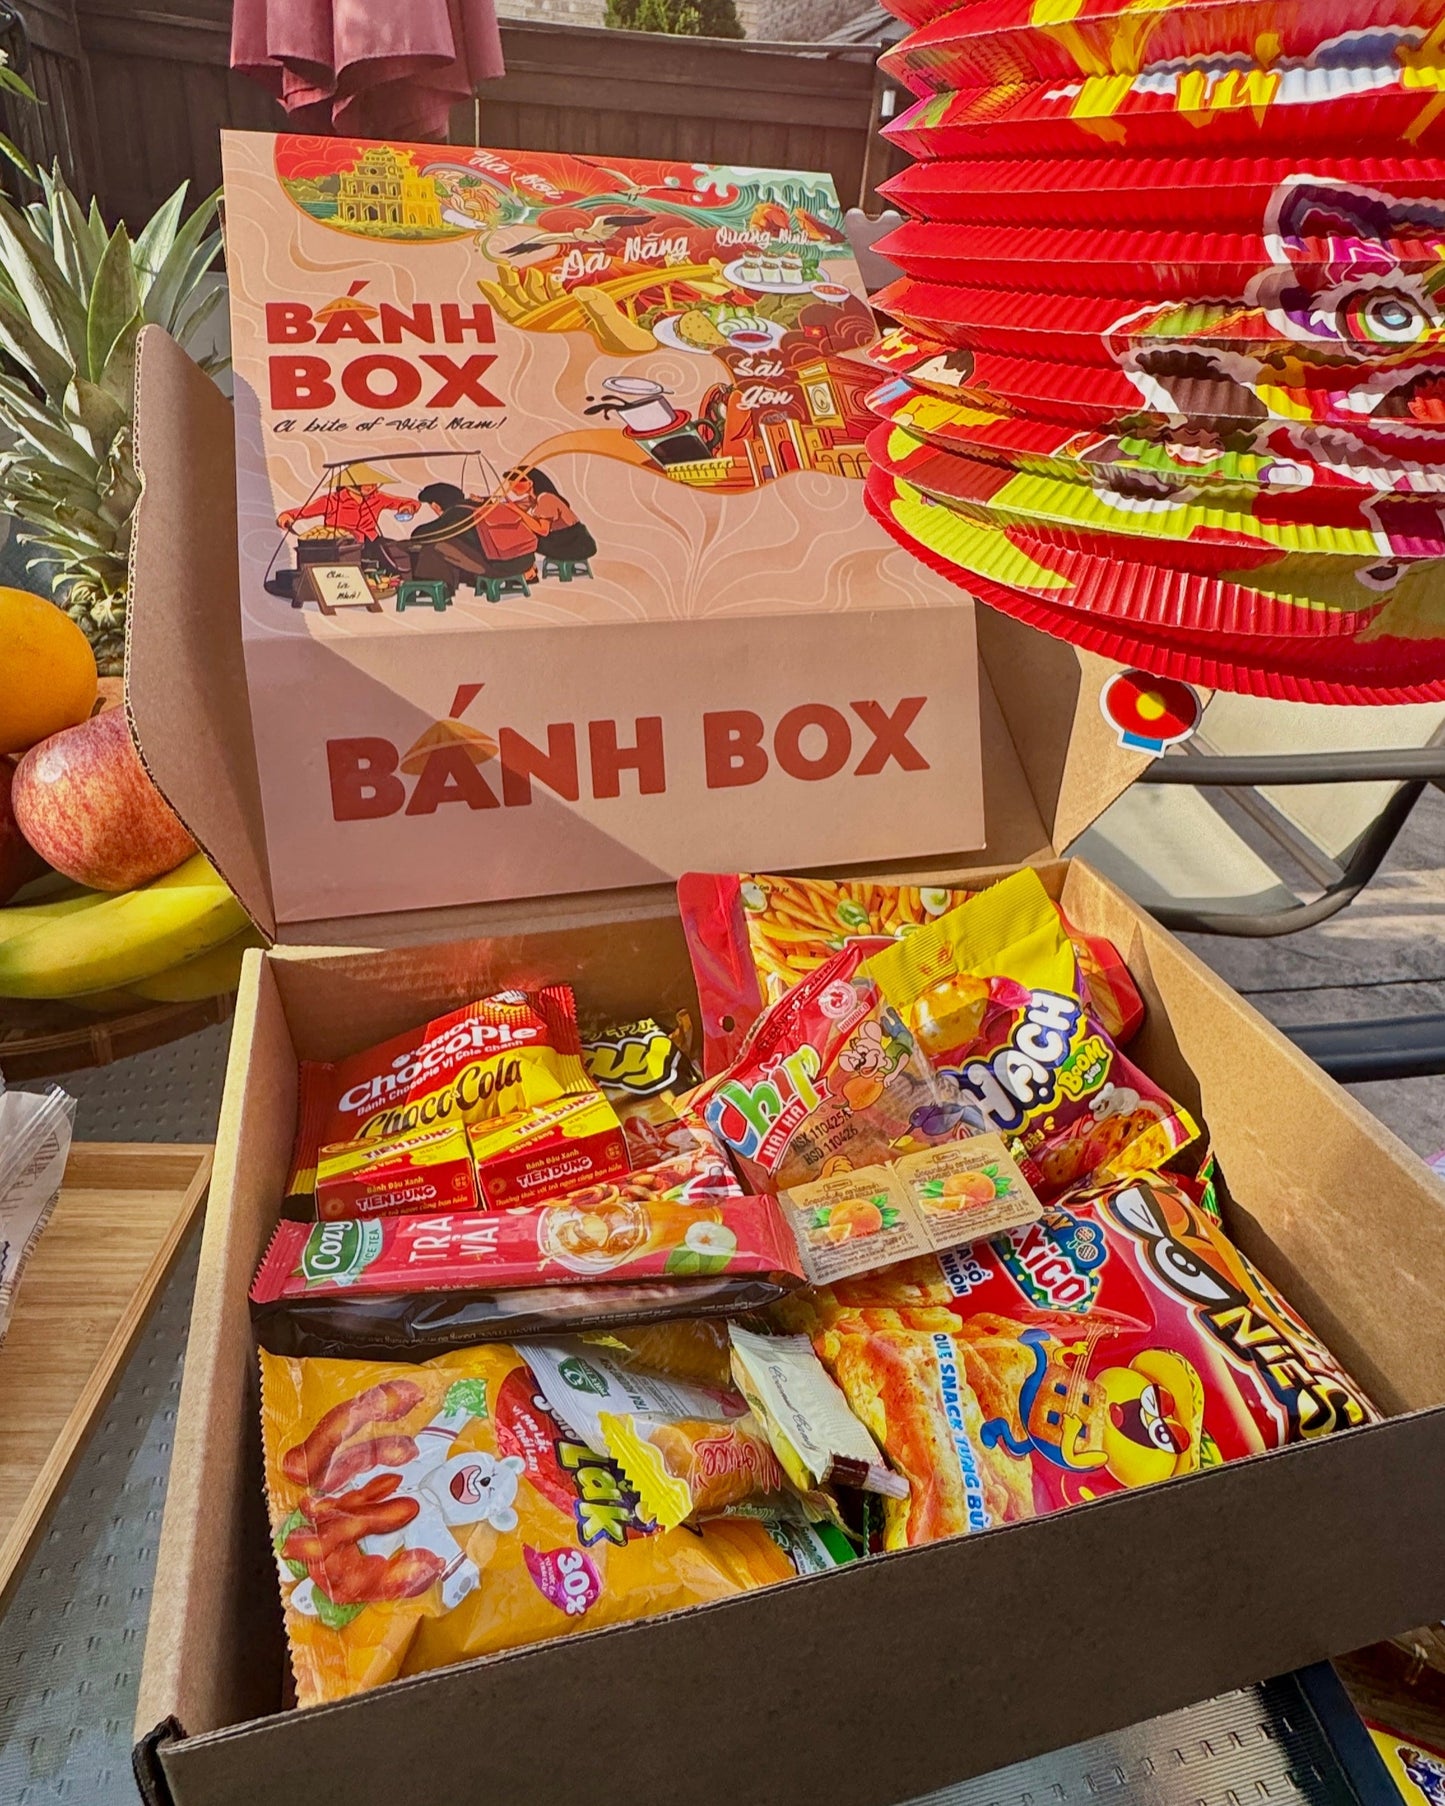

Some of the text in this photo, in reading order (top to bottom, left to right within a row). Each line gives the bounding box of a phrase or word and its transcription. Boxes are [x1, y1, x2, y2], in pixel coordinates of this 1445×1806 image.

[265, 280, 497, 344] BÁNH
[268, 354, 506, 410] BOX
[303, 418, 349, 432] bite
[355, 417, 385, 432] of
[385, 417, 439, 433] Việt
[444, 416, 507, 431] Nam!
[326, 683, 931, 822] BÁNH BOX
[311, 1221, 354, 1270] Cozy
[363, 1227, 380, 1267] ICE TEA
[408, 1216, 454, 1263] TRÀ
[933, 1334, 953, 1359] QUE
[941, 1363, 964, 1432] SNACK
[557, 1550, 590, 1615] 30%
